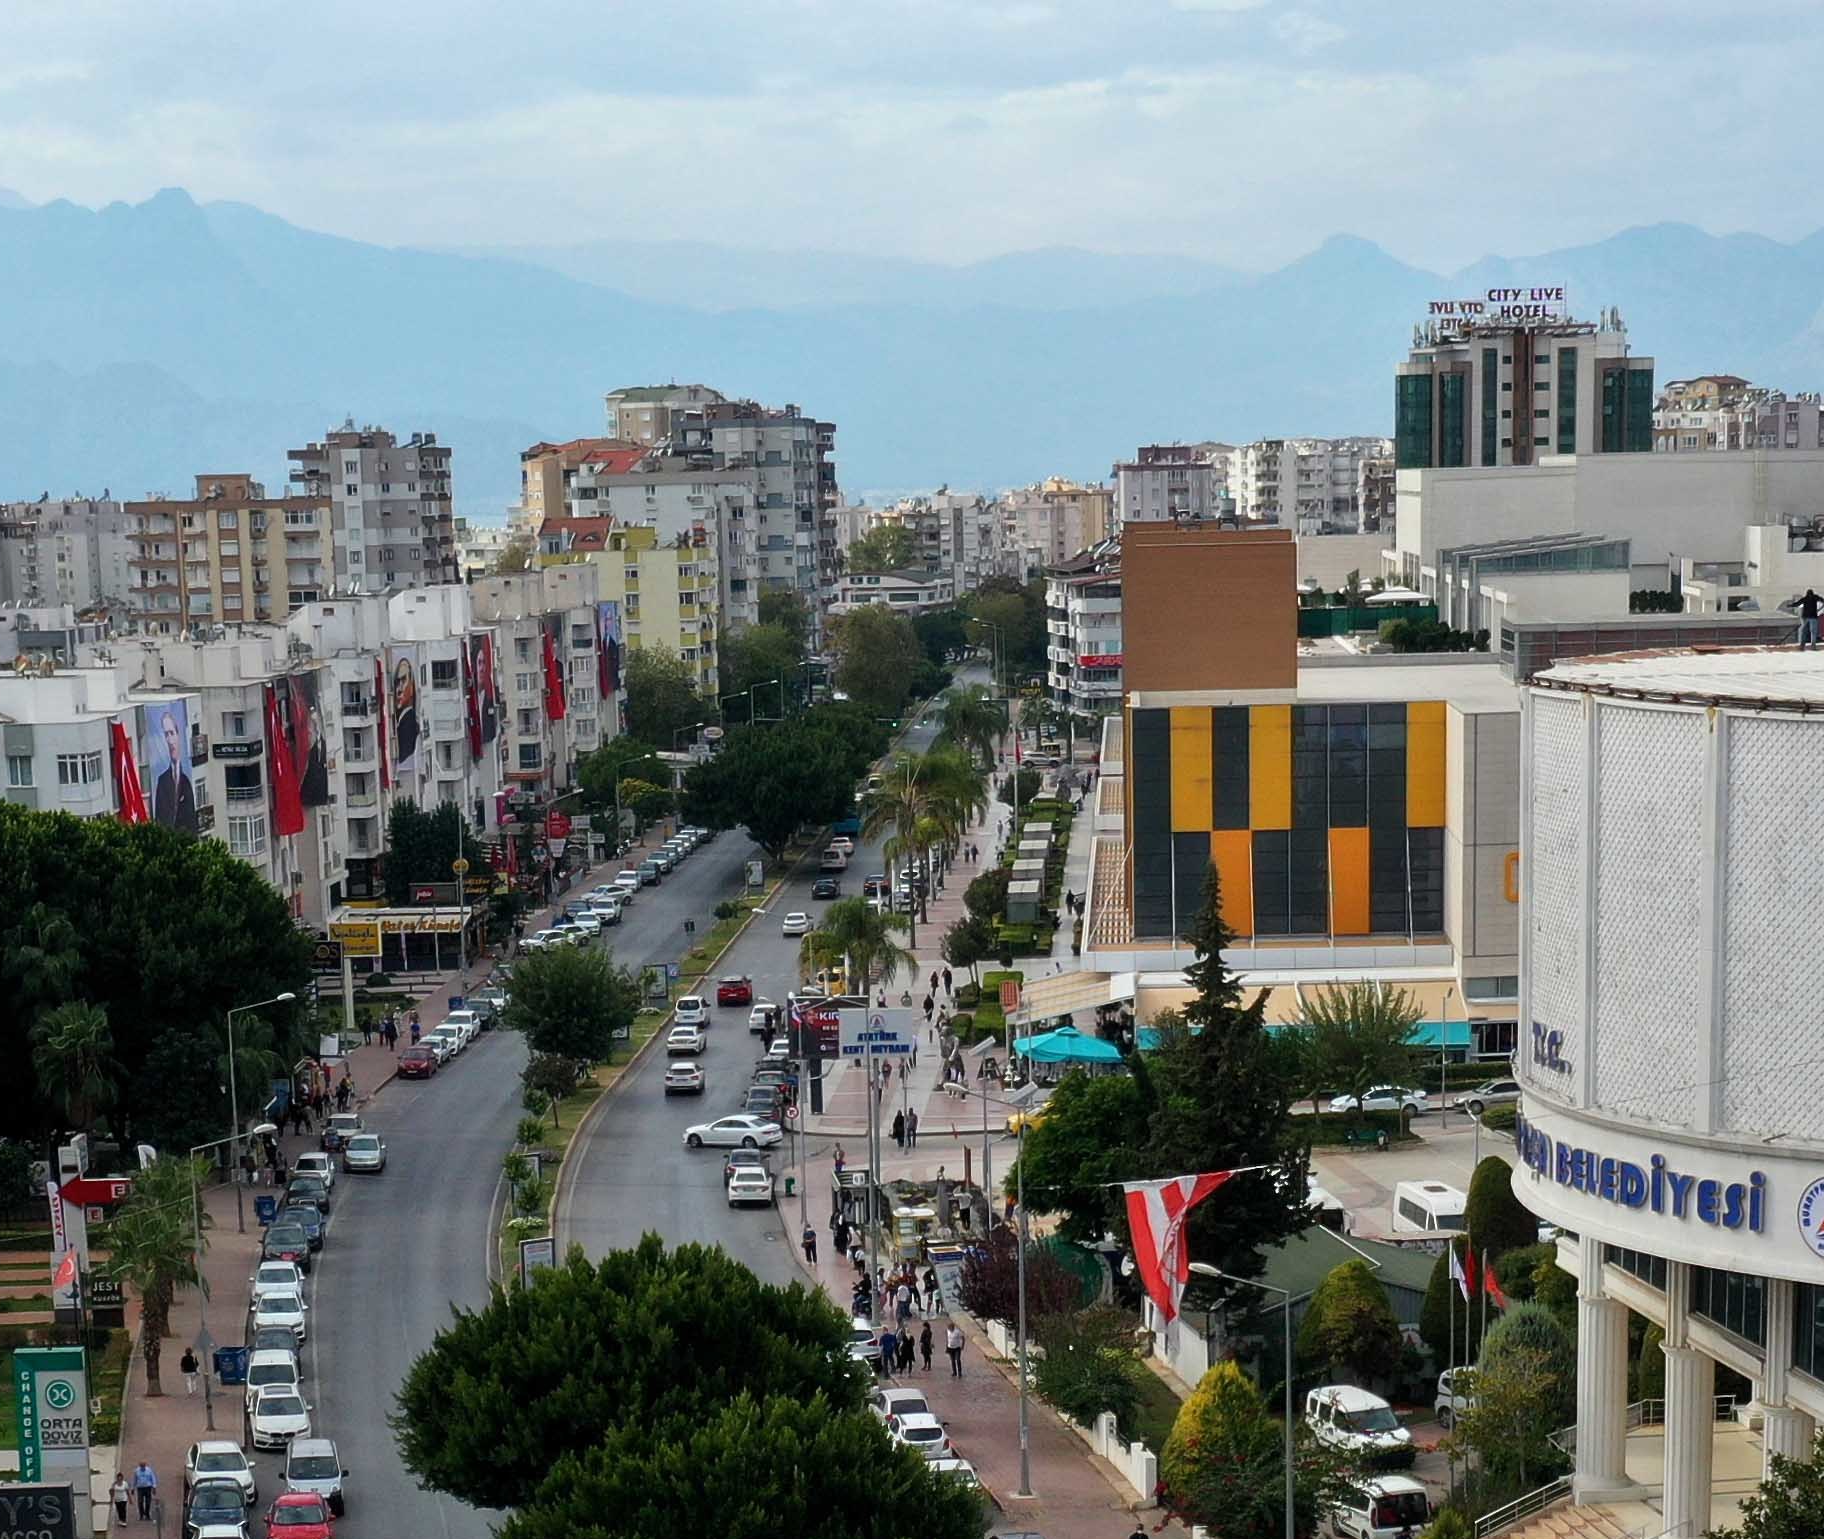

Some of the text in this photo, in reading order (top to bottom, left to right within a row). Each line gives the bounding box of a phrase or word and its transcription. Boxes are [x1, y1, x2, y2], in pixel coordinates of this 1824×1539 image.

[1487, 287, 1563, 301] CITY LIVE
[1500, 304, 1552, 318] HOTEL
[857, 1029, 898, 1042] ATATÜRK
[842, 1044, 865, 1055] KENT
[1555, 1141, 1767, 1234] BELEDİYESİ
[93, 1281, 120, 1292] JEST
[40, 1418, 83, 1430] ORTA
